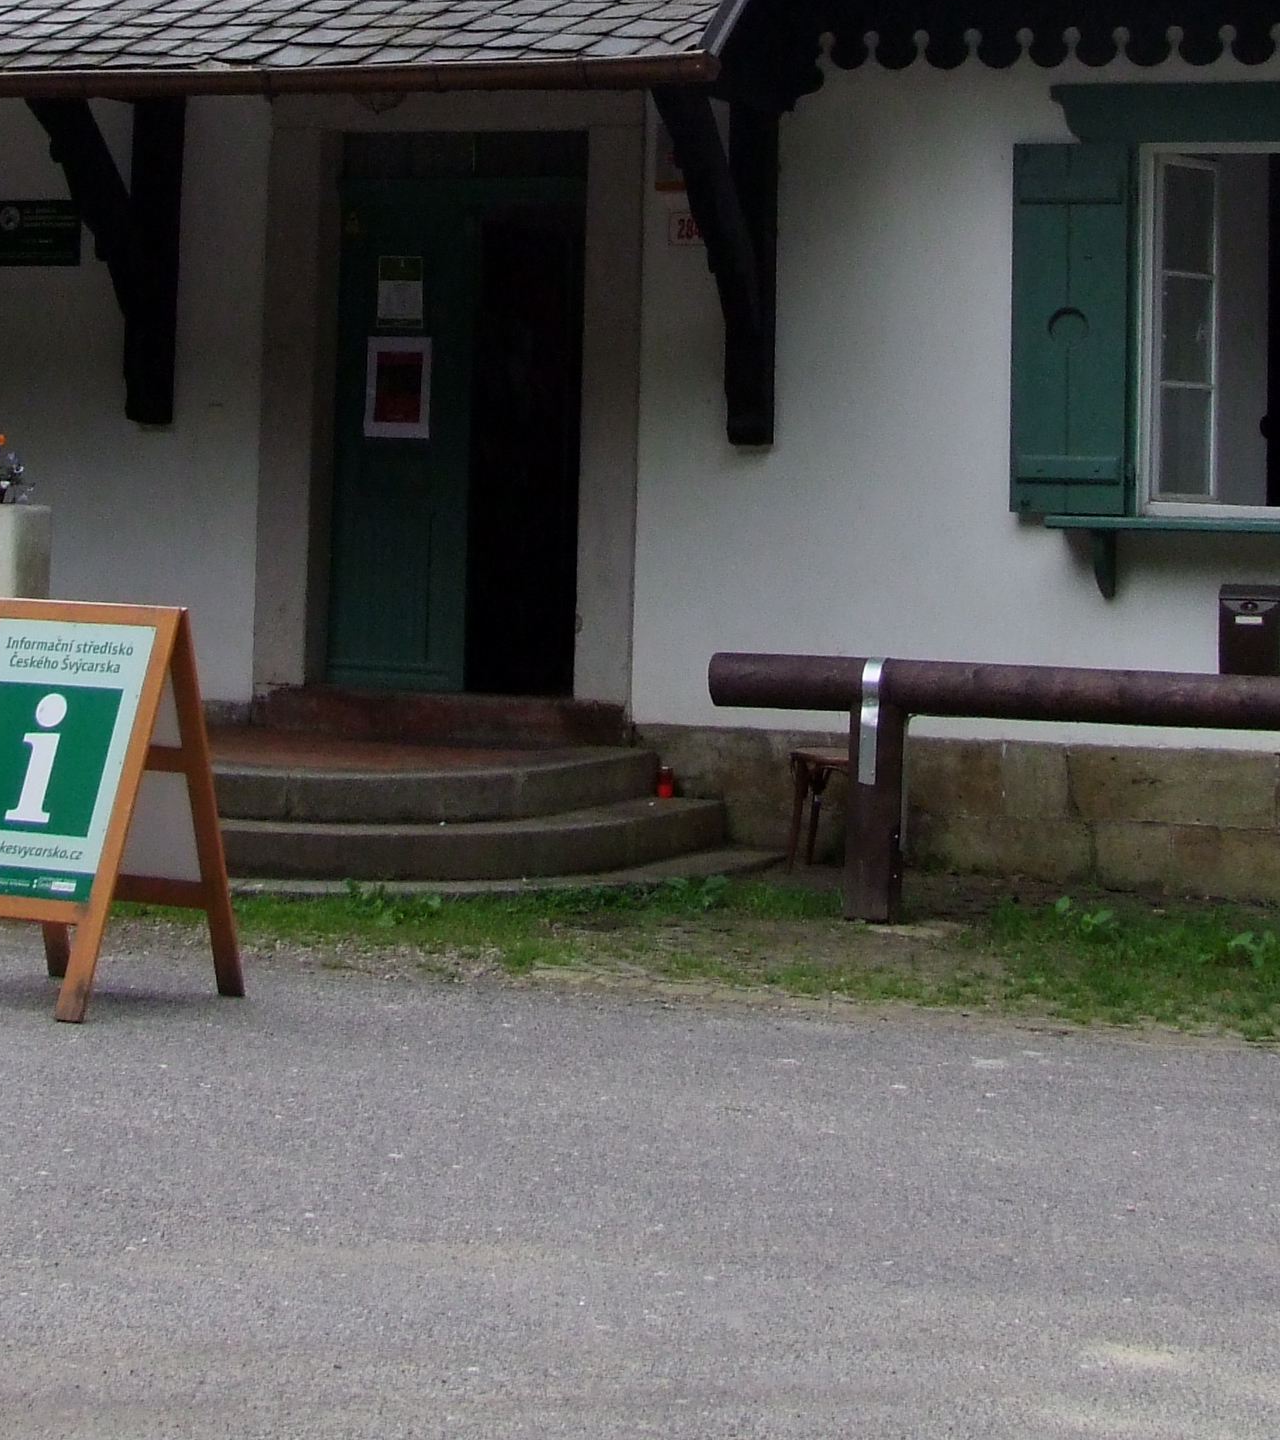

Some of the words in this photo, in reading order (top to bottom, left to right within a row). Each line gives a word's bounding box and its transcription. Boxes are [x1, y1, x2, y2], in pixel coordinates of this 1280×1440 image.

[6, 636, 75, 652] Informační
[75, 640, 134, 656] středisko
[9, 651, 59, 669] Českého
[60, 654, 121, 674] Švýcarska
